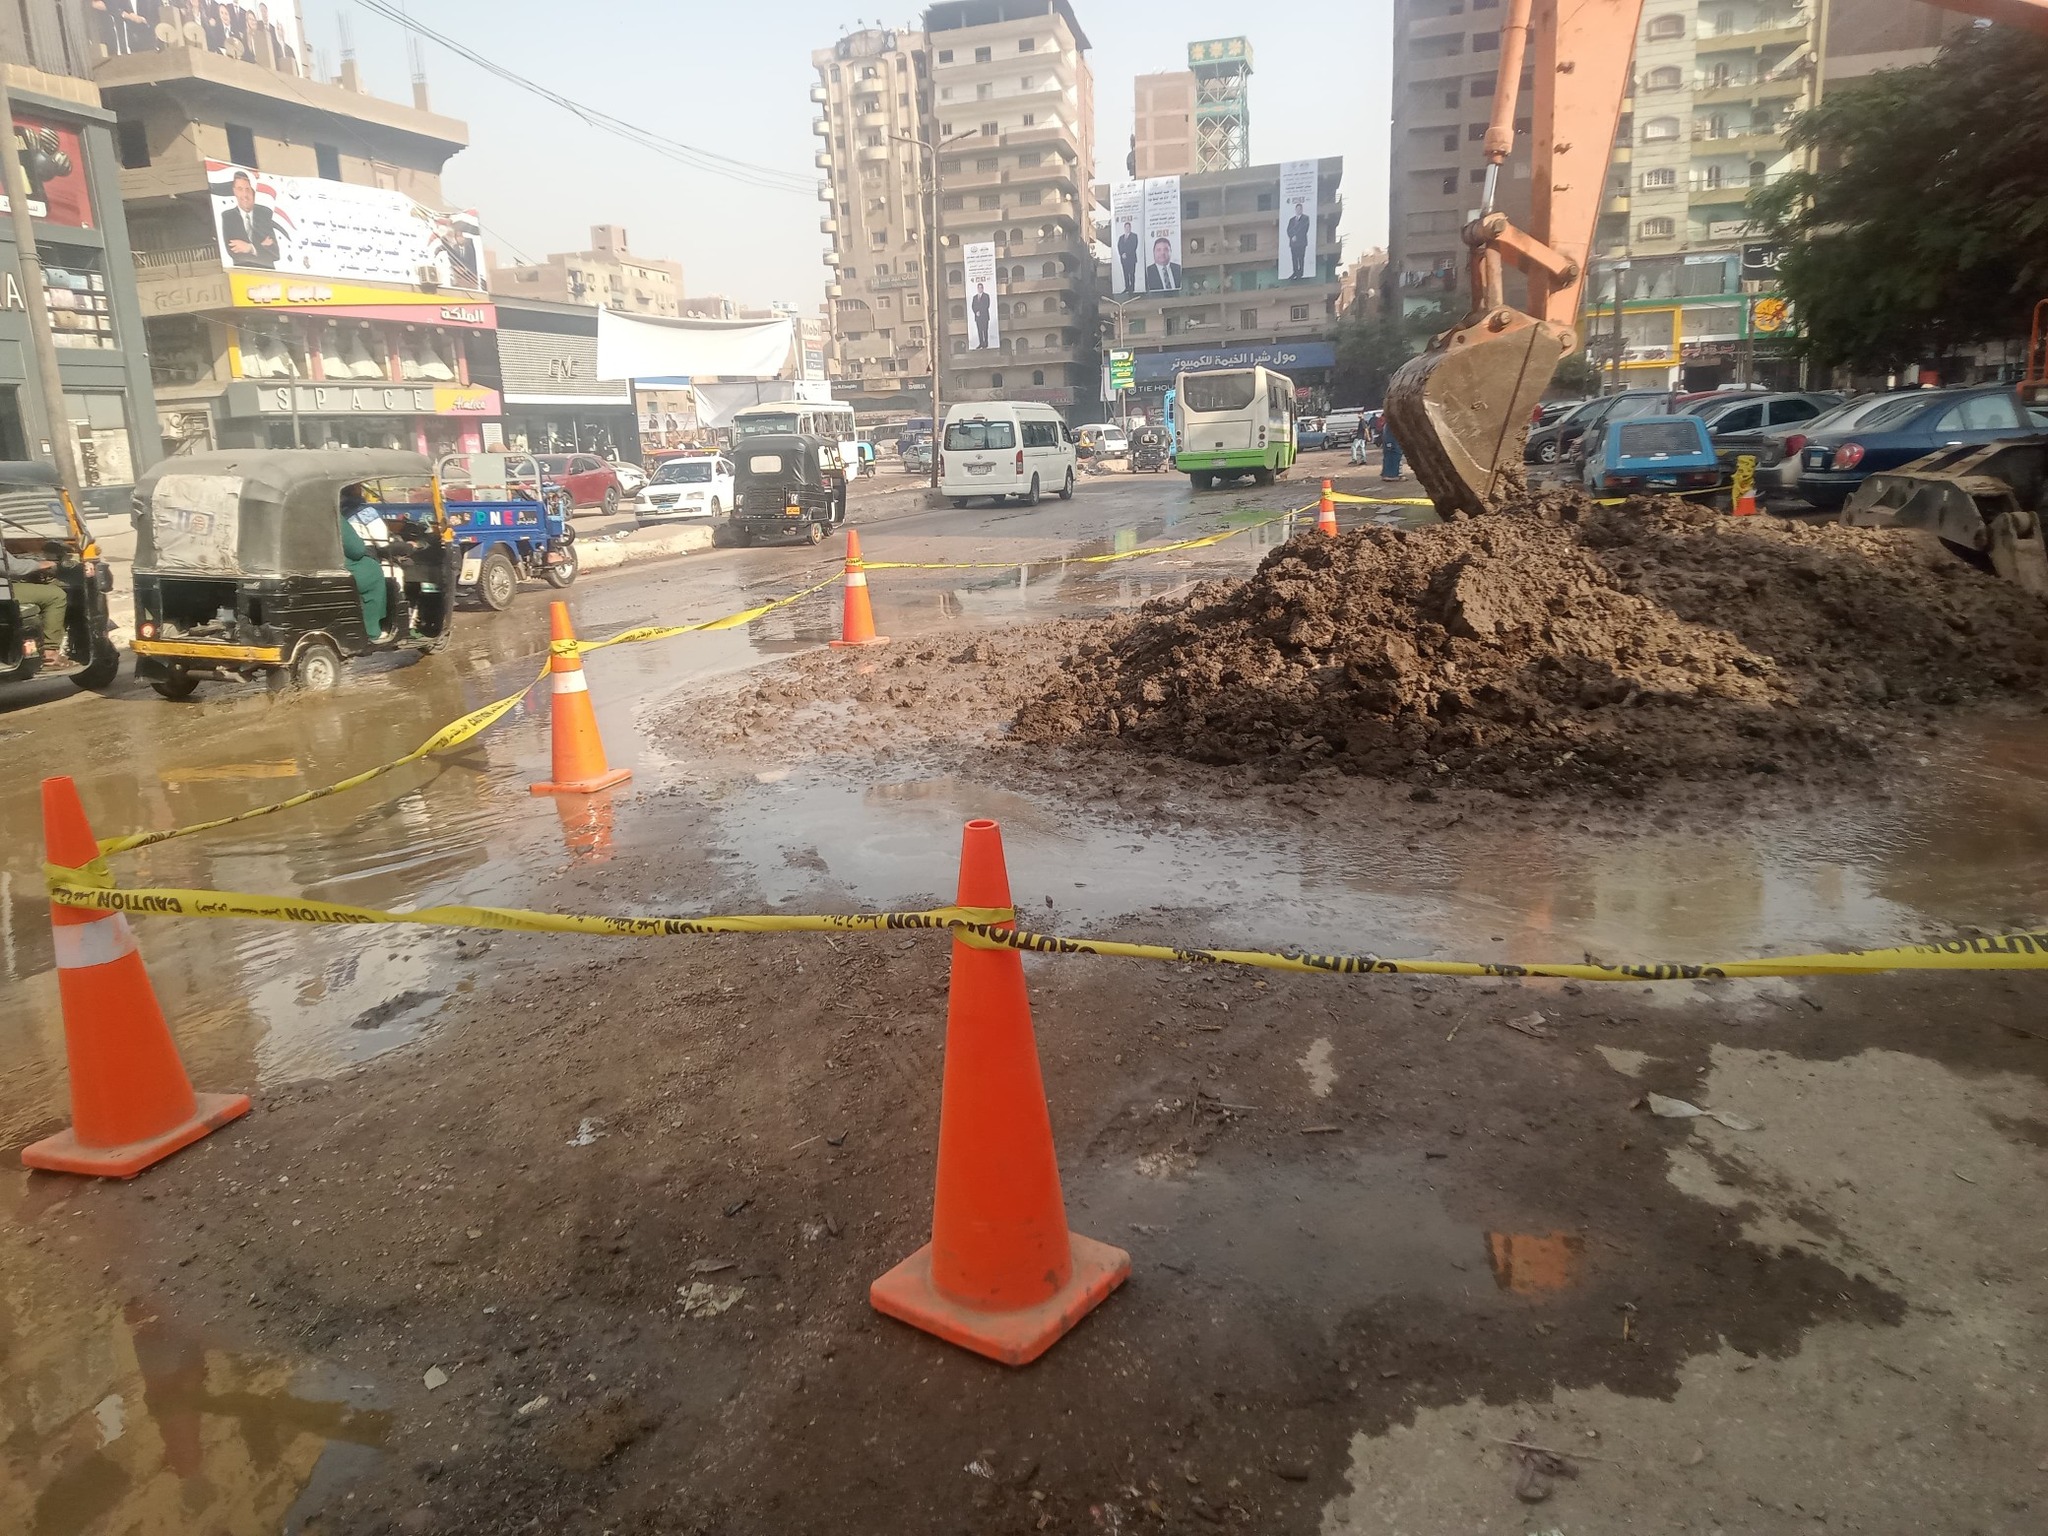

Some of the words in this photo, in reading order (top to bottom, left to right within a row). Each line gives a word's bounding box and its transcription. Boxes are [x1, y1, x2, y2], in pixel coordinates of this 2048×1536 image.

[0, 272, 25, 309] A
[440, 306, 485, 324] الملكة
[1170, 355, 1213, 371] للكمبيوتر
[1214, 354, 1248, 368] الخيمة
[1249, 350, 1271, 366] شبرا
[1272, 350, 1297, 366] مول
[1138, 385, 1153, 393] TIE
[1154, 384, 1174, 392] HOU
[276, 387, 425, 412] SPACE
[96, 892, 183, 914] CAUTION
